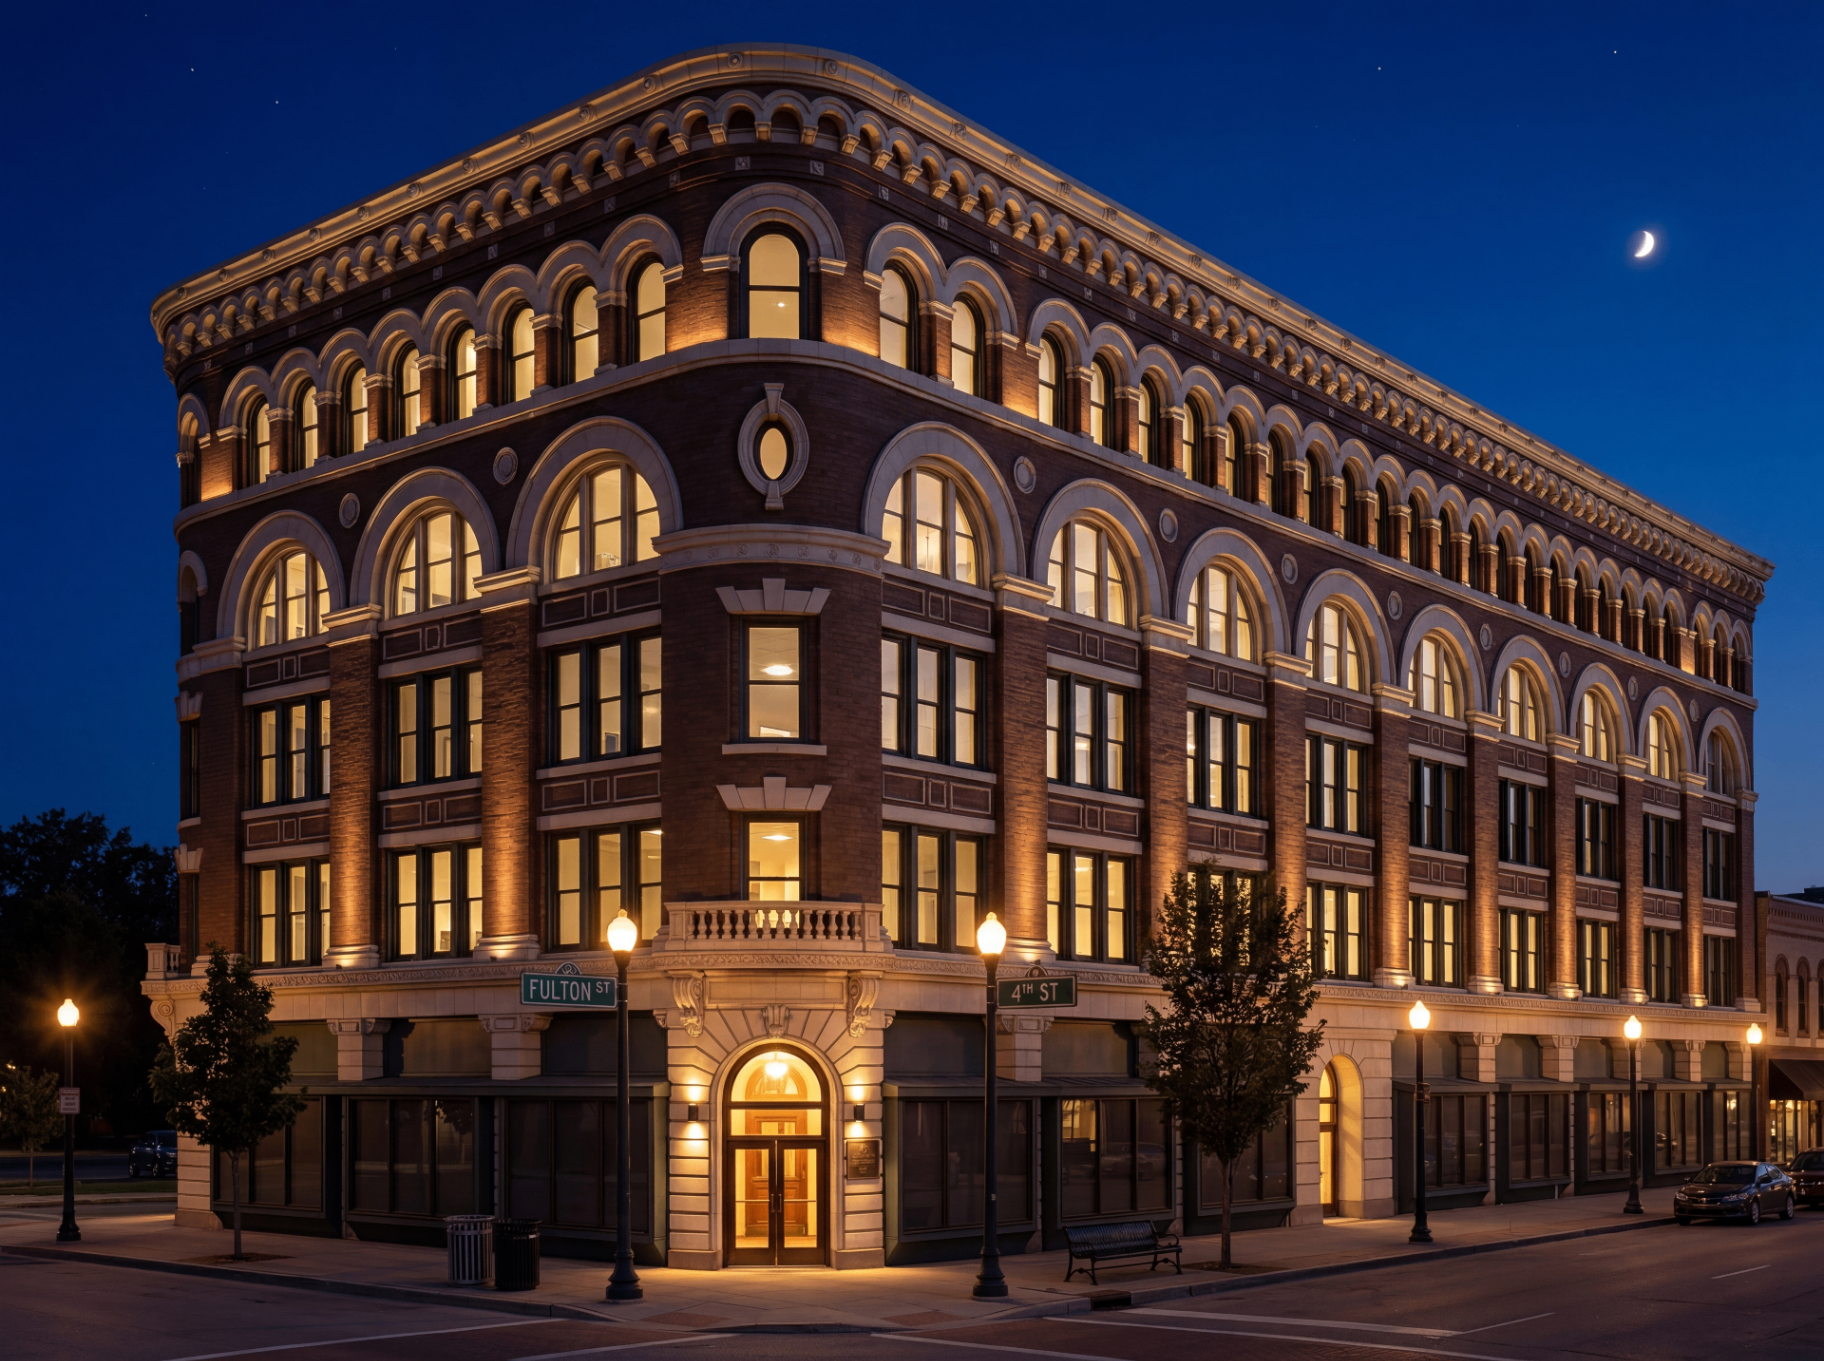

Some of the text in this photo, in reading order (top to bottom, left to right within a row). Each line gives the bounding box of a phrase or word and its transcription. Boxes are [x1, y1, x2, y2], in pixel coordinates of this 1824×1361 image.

[529, 979, 611, 1001] FULTON ST
[1011, 982, 1059, 1003] 4TH ST
